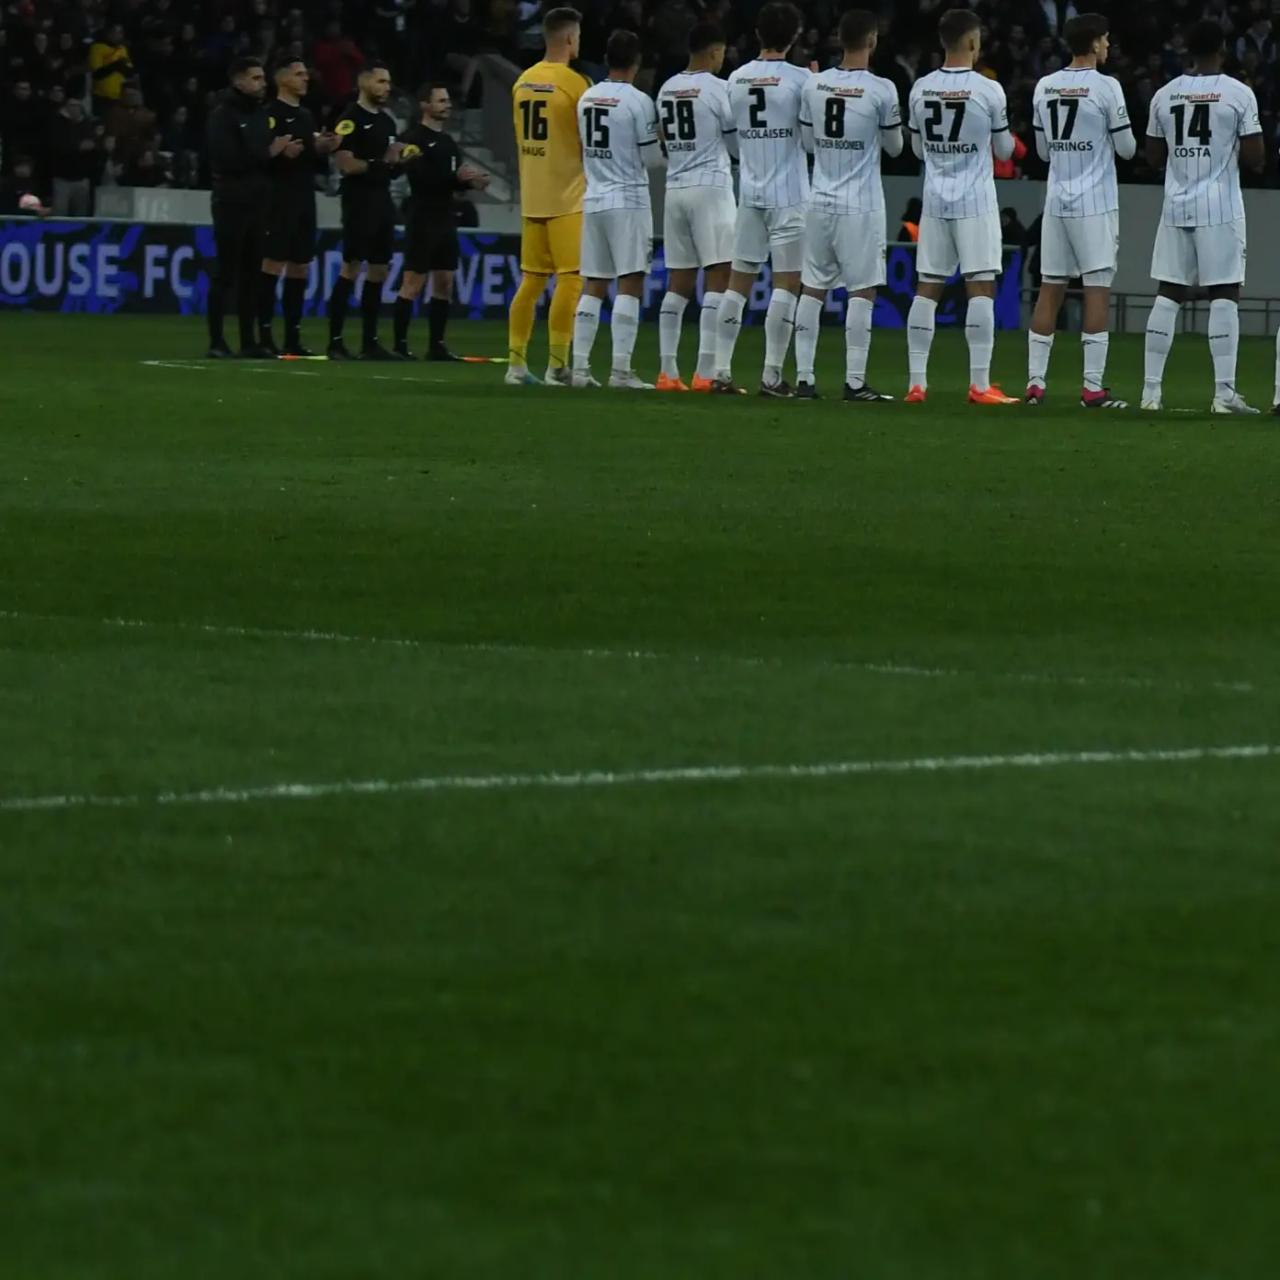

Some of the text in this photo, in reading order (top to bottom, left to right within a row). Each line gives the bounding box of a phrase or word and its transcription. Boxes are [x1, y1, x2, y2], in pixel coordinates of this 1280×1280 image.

[520, 100, 548, 141] 16
[583, 107, 609, 149] 15
[661, 100, 696, 141] 28
[748, 87, 768, 128] 2
[824, 97, 846, 138] 8
[924, 100, 966, 142] 27
[1046, 98, 1079, 140] 17
[1170, 103, 1212, 146] 14
[1174, 147, 1212, 158] COSTA
[144, 244, 195, 299] FC
